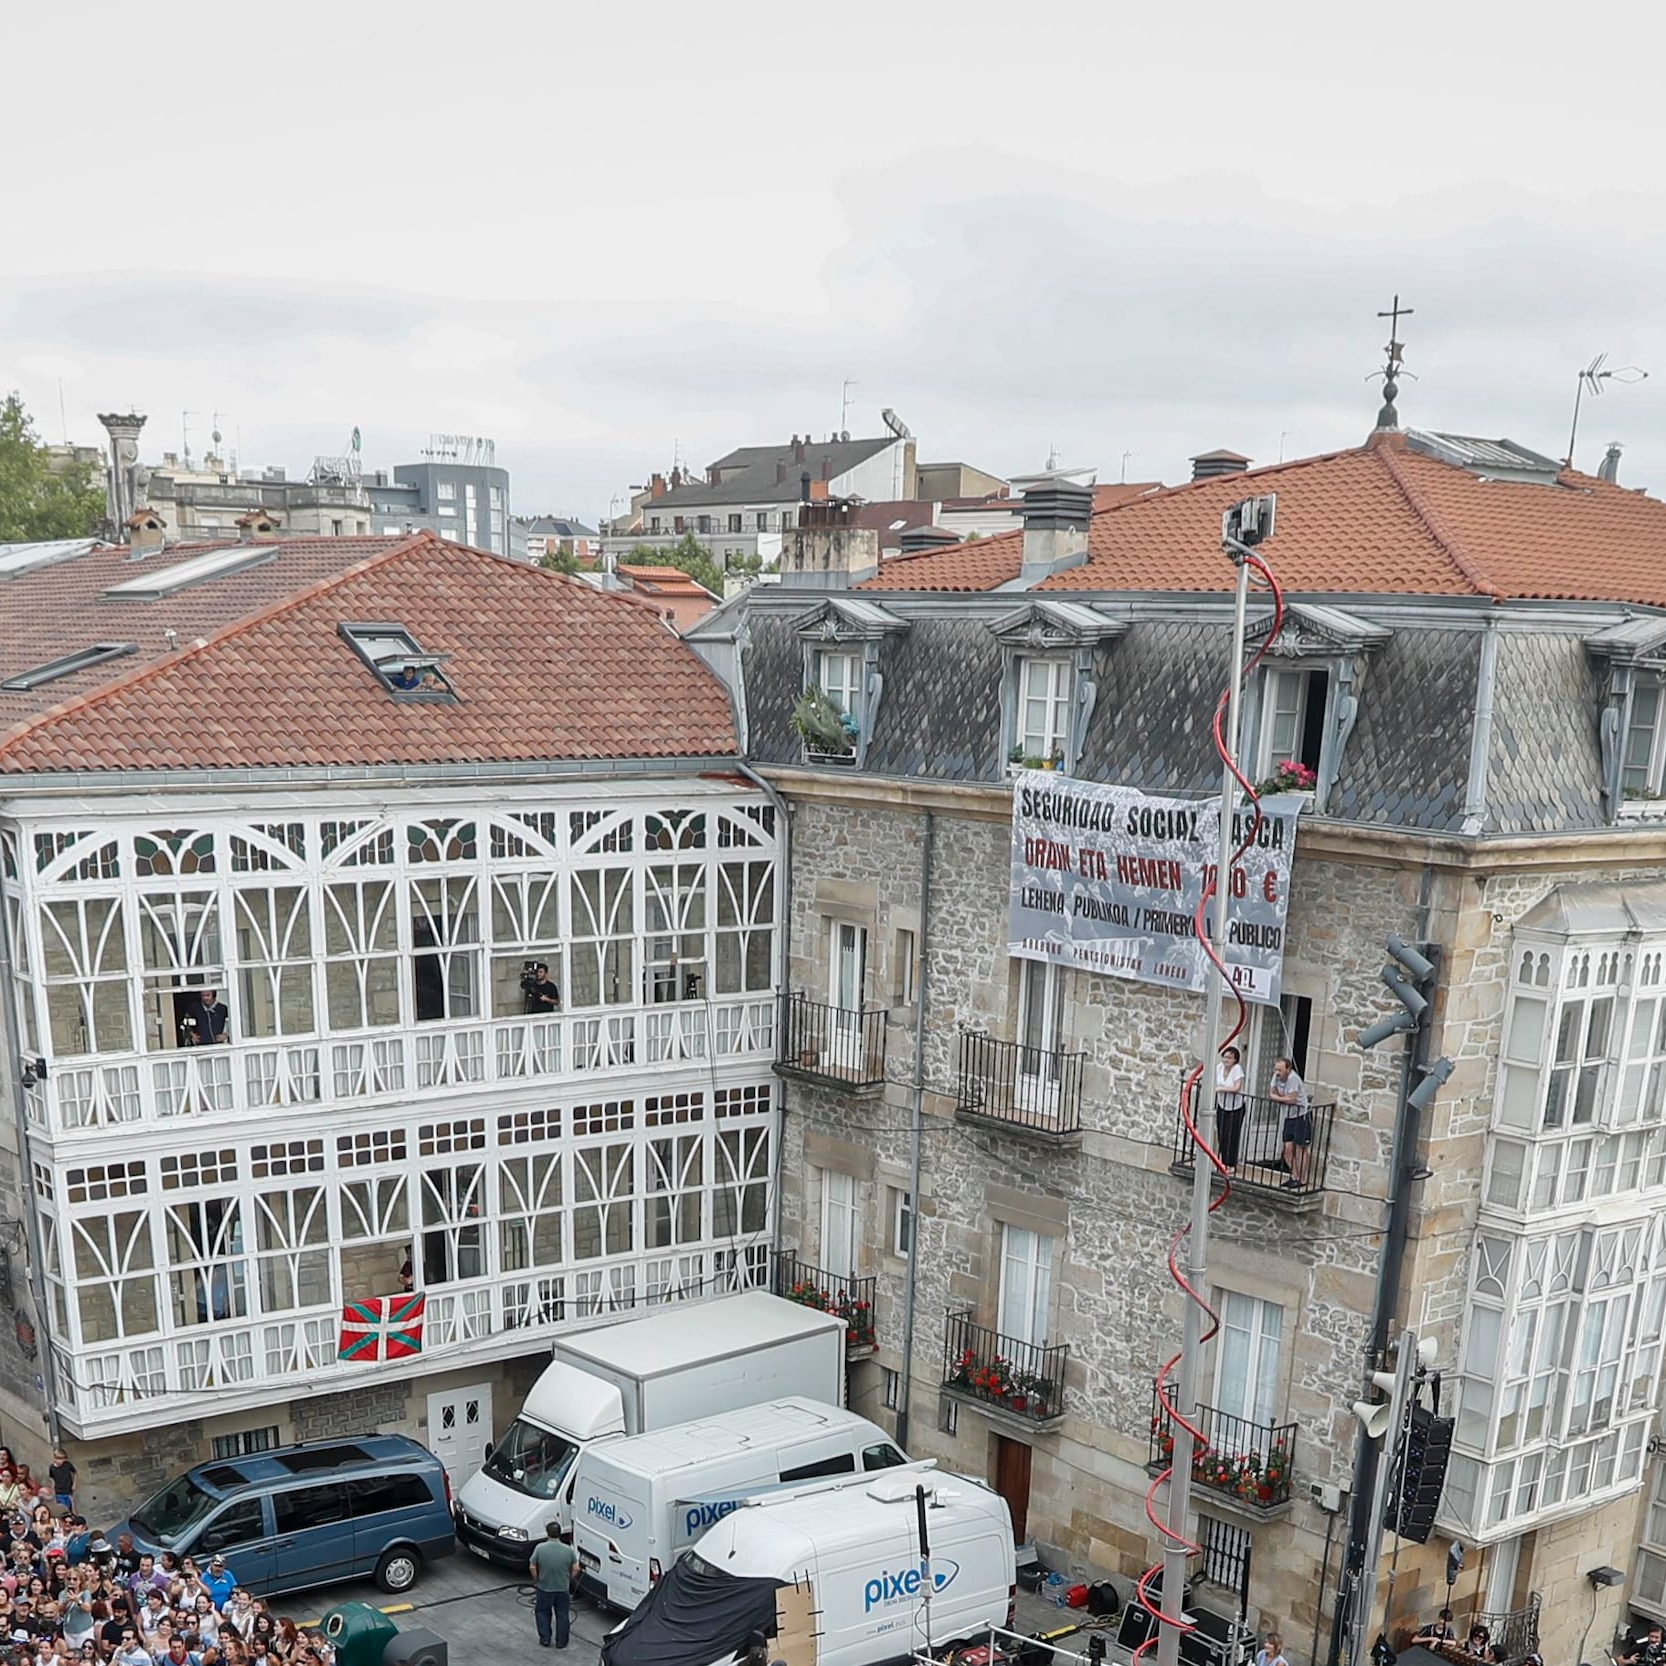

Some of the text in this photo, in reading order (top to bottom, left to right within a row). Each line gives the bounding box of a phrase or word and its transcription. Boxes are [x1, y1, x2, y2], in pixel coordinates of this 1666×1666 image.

[1022, 788, 1284, 849] SEGURIDAD SOCIAL ASCA
[1025, 837, 1278, 903] ORAIN ETA HEMEN 100 €
[1021, 887, 1065, 916] LEHENA
[1073, 895, 1129, 928] PUBLIKOA
[1229, 921, 1282, 950] PUBLICO
[588, 1496, 616, 1522] pixel
